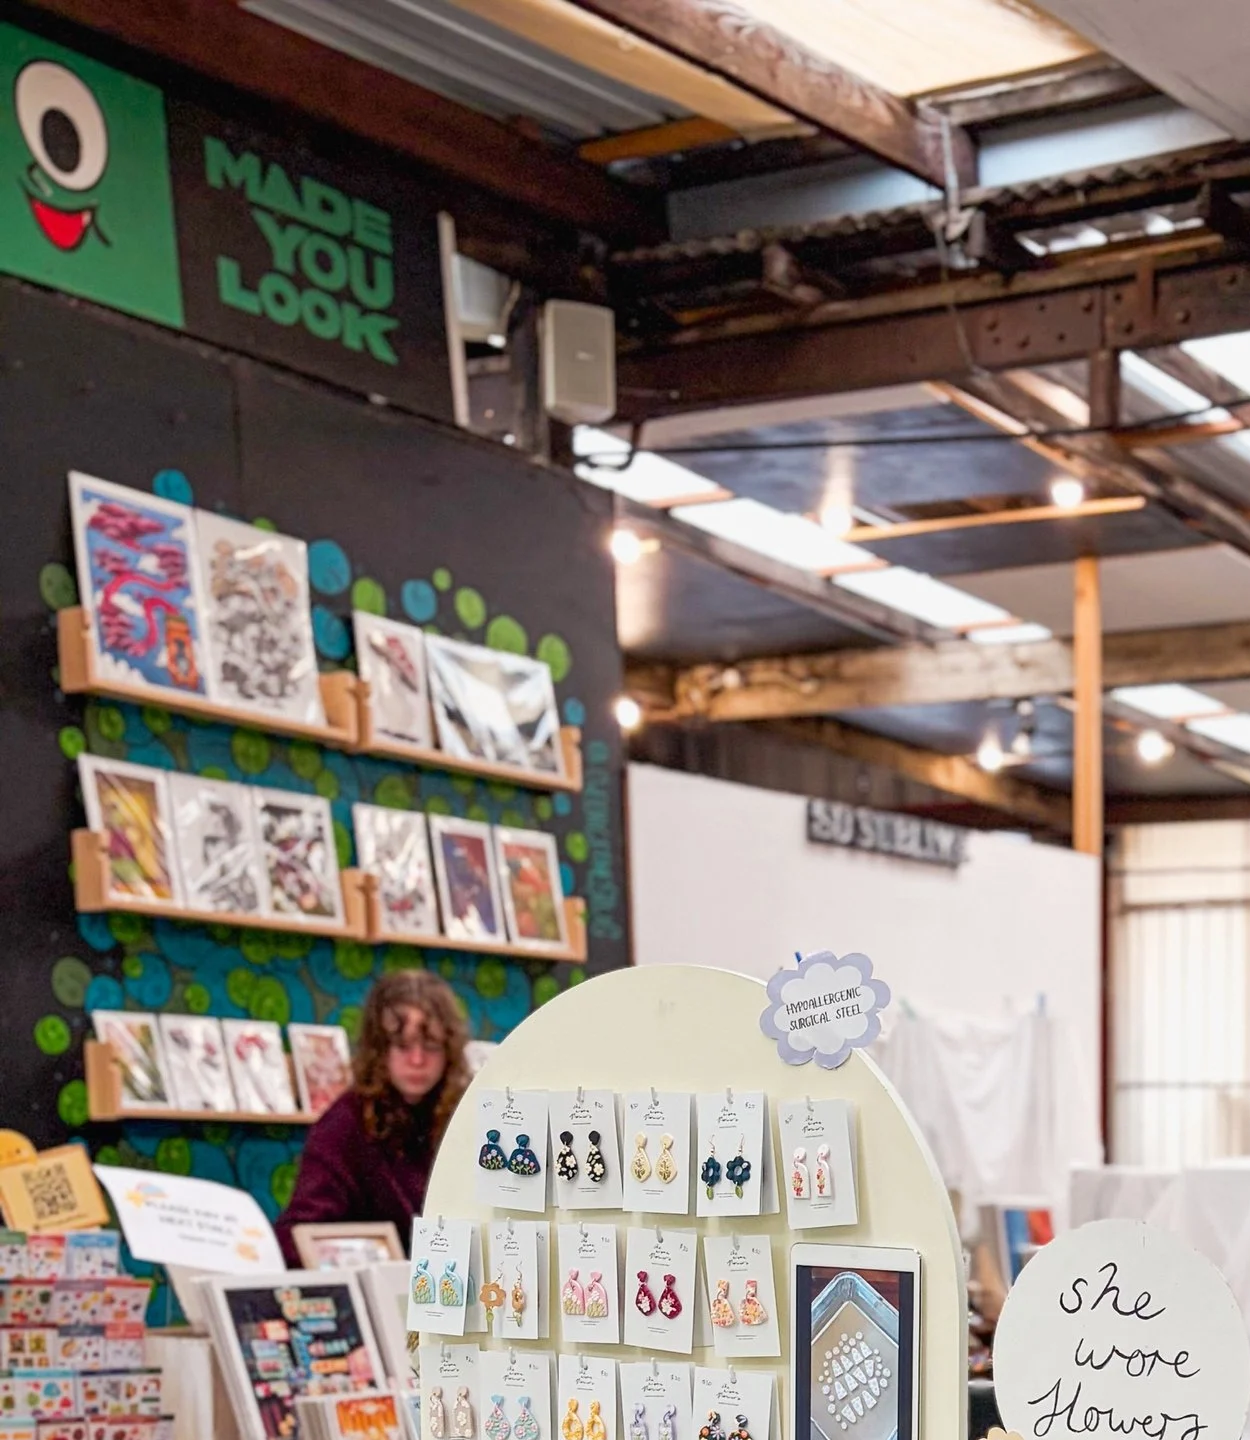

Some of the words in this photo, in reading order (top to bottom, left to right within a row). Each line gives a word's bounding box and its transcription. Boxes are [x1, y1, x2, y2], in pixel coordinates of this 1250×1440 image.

[204, 136, 393, 256] MADE
[252, 211, 394, 311] YOU
[217, 257, 398, 365] LOOK
[786, 986, 862, 1015] HYPOALLERGENIC
[789, 1011, 831, 1031] SURGICAL
[835, 1004, 863, 1020] STEEL
[1059, 1262, 1166, 1320] she
[1074, 1338, 1201, 1378] wore
